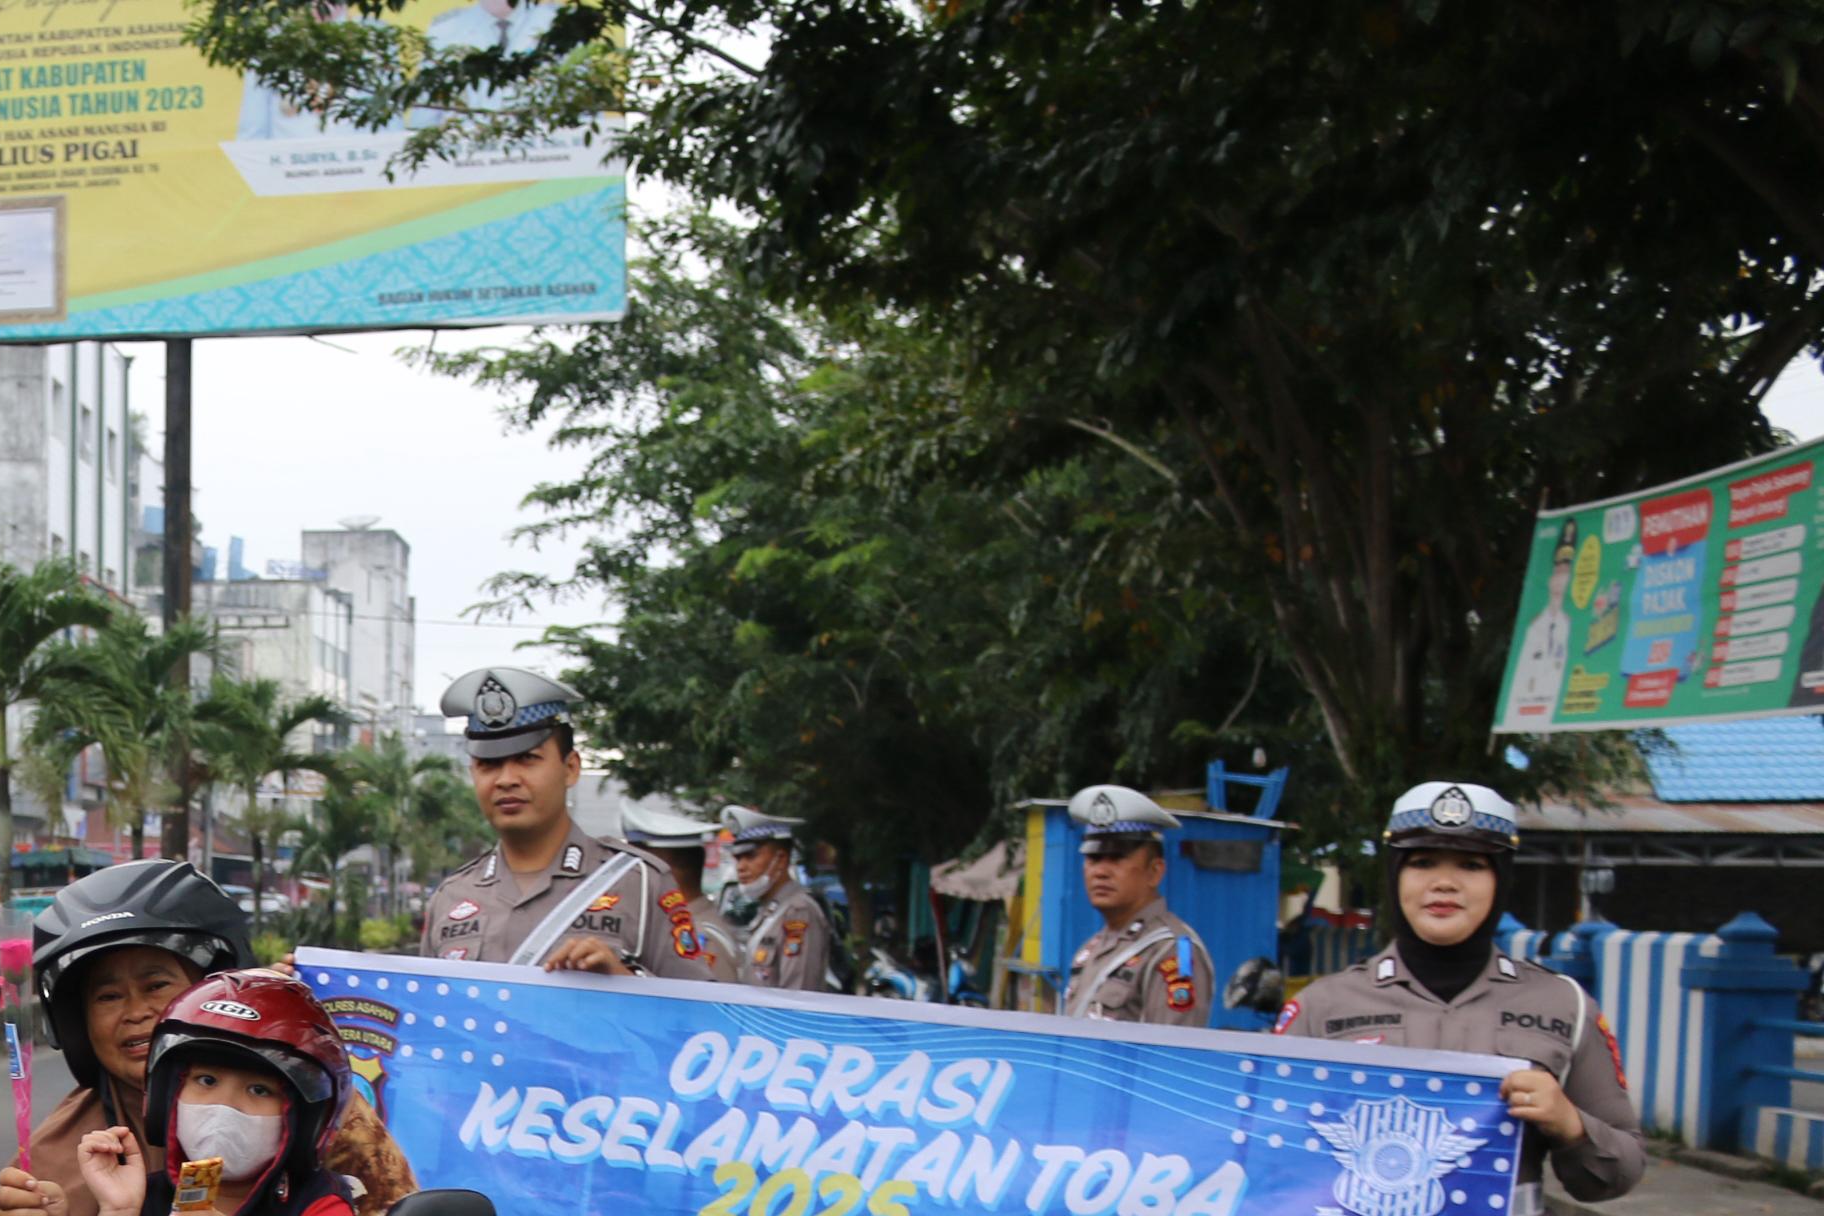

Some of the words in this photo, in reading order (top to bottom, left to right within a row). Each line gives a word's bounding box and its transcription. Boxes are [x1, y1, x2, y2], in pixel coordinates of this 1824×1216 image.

[37, 26, 123, 42] KABUPATEN
[32, 43, 103, 58] REPUBLIK
[19, 59, 147, 90] KABUPATEN
[68, 90, 140, 117] TAHUN
[145, 84, 205, 112] 2023
[4, 129, 34, 142] HAK
[38, 126, 81, 141] ASASI
[84, 122, 149, 138] MANUSIA
[62, 138, 140, 164] PIGAI
[1644, 557, 1697, 588] DISKON
[1642, 586, 1687, 615] PAJAK
[80, 911, 136, 929] HONDA
[440, 919, 480, 940] REZA
[572, 916, 622, 935] OLRI
[322, 1000, 356, 1014] OLRES
[356, 1001, 397, 1023] ASAHAN
[1500, 1010, 1573, 1038] POLRI
[669, 1029, 1016, 1130] OPERASI
[458, 1080, 1022, 1206] KESELAMATAN
